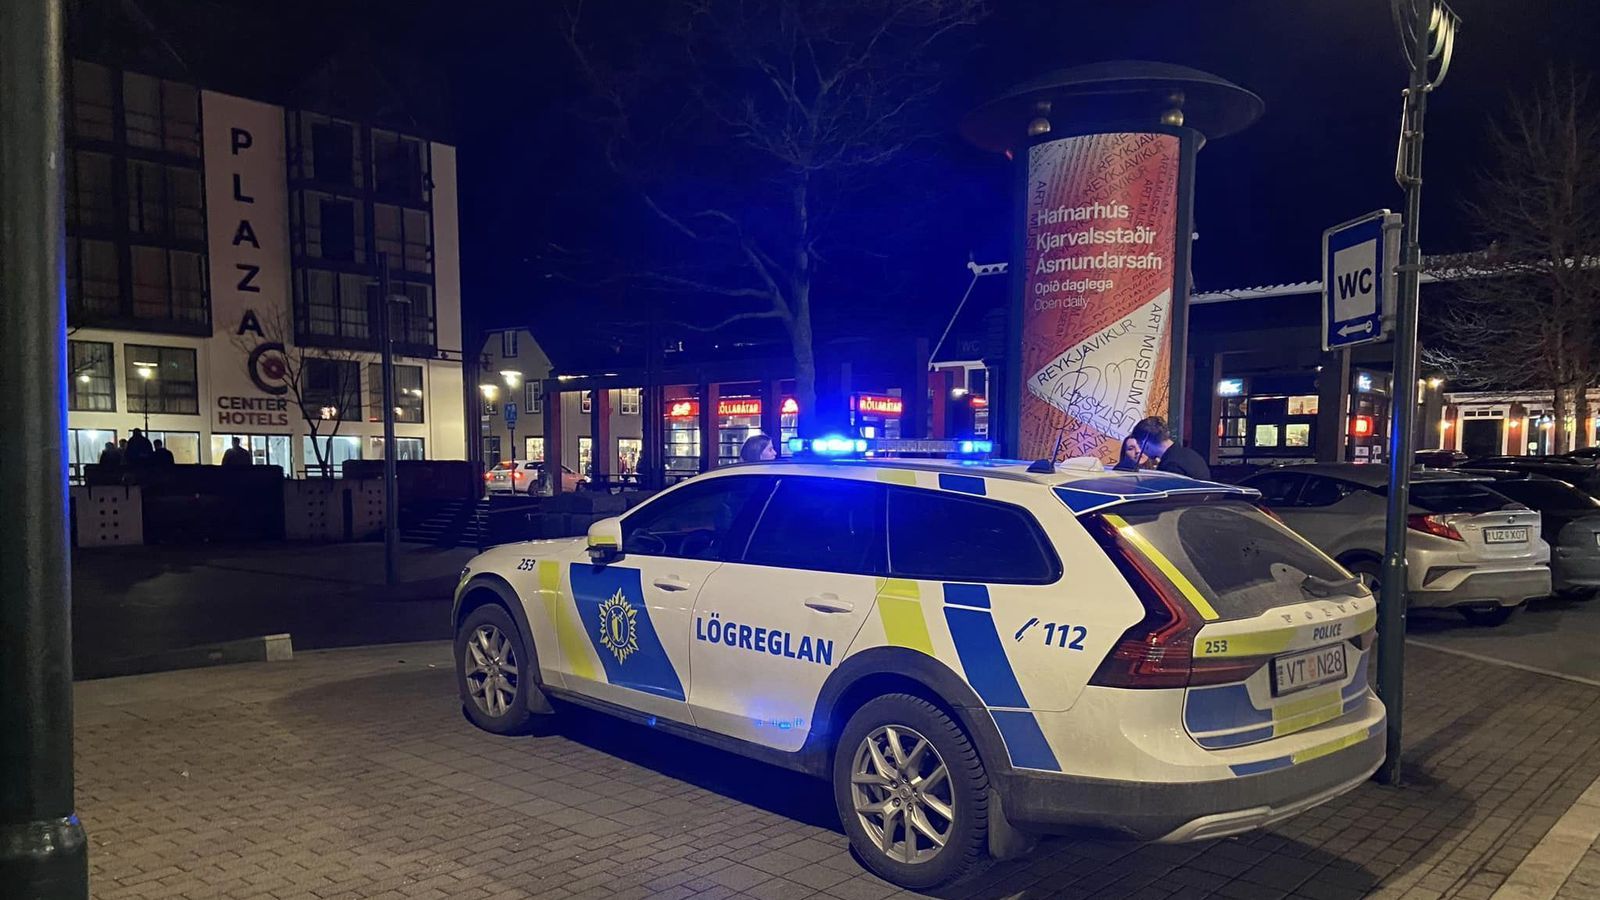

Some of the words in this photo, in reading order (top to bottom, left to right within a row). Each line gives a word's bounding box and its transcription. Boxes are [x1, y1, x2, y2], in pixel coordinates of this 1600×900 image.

[1037, 200, 1129, 227] Hafnarhús
[231, 127, 264, 337] PLAZA
[1036, 226, 1156, 253] Kjarvalsstaðir
[1035, 251, 1162, 275] Ásmundarsafn
[1034, 281, 1060, 296] Opið
[1061, 278, 1114, 294] daglega
[1338, 267, 1372, 300] WC
[1034, 297, 1062, 311] Open
[1063, 295, 1090, 310] daily
[1148, 303, 1163, 332] ART
[1128, 335, 1156, 406] MUSEUM
[217, 396, 288, 411] CENTER
[218, 411, 289, 427] HOTELS
[517, 558, 536, 571] 253
[696, 612, 834, 666] LÖGREGLAN
[1044, 622, 1088, 651] 112
[1313, 623, 1342, 641] POLICE
[1205, 640, 1228, 653] 253
[1286, 660, 1306, 684] VT
[1317, 653, 1342, 679] N28
